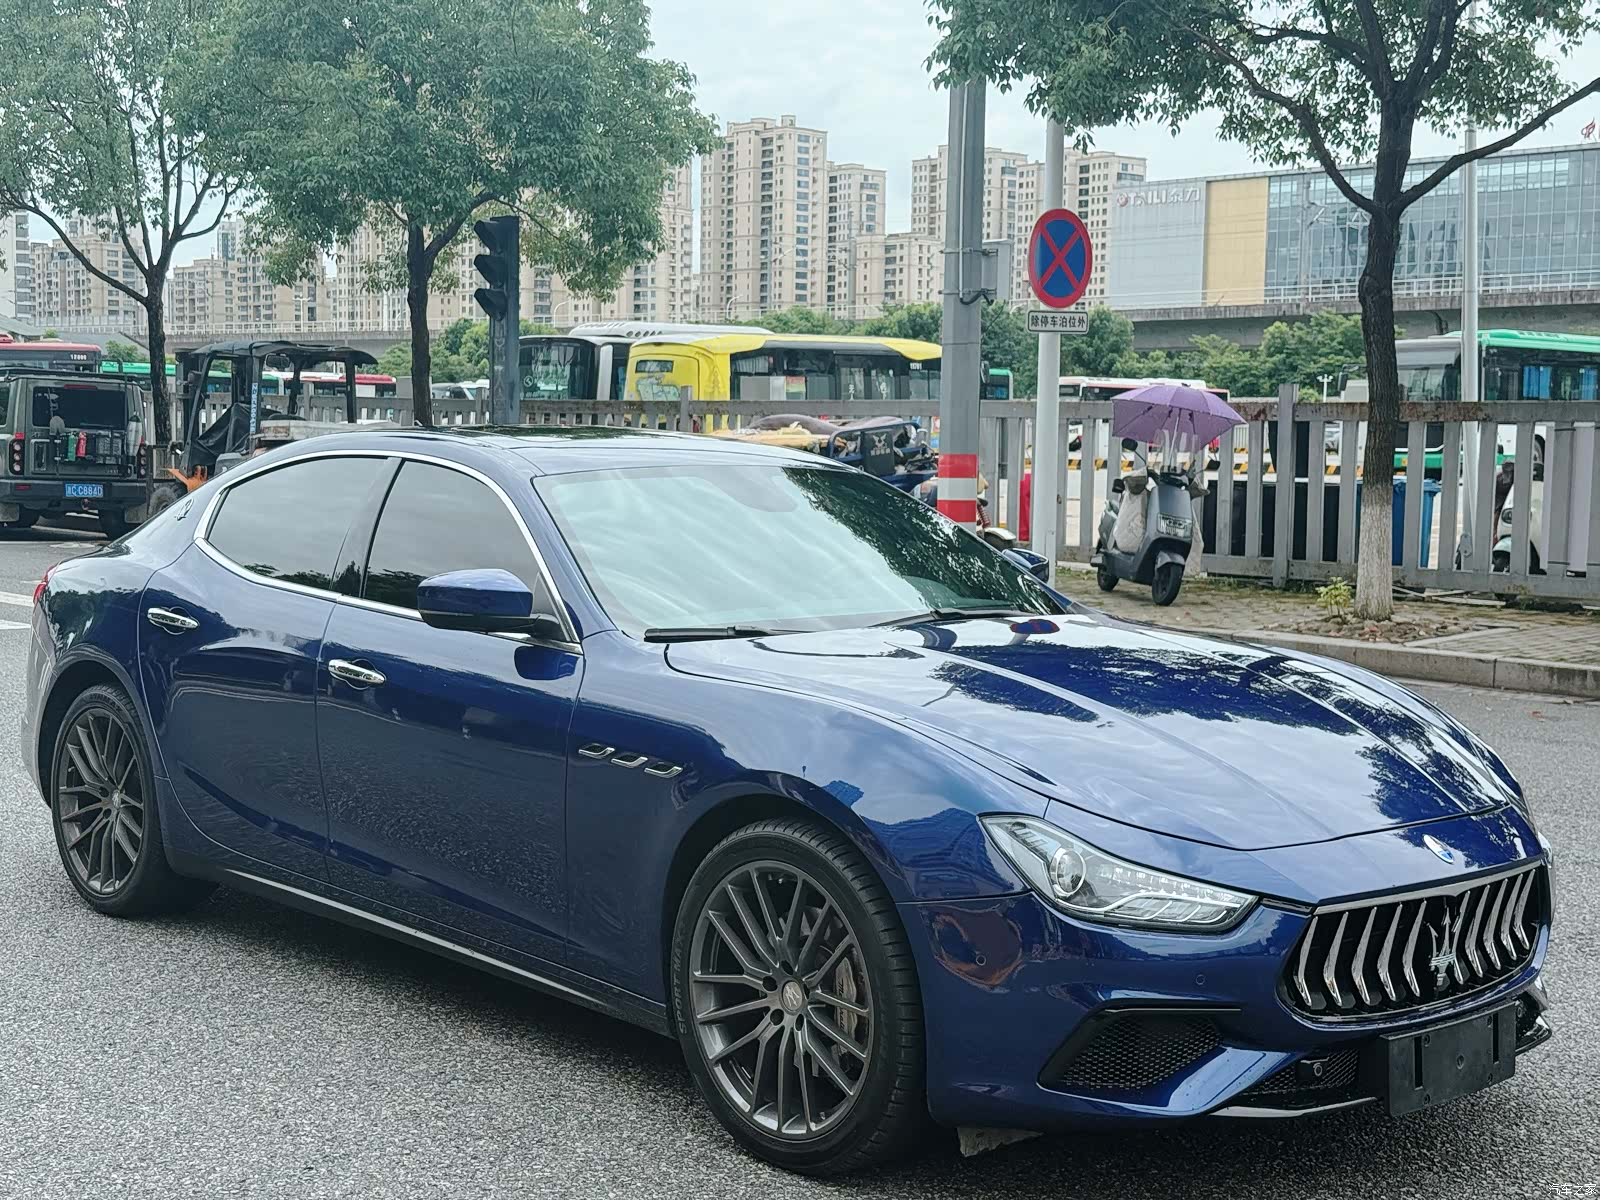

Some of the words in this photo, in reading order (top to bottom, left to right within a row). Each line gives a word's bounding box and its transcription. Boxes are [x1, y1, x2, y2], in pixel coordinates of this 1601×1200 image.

[1030, 315, 1086, 329] 除停车泊位外
